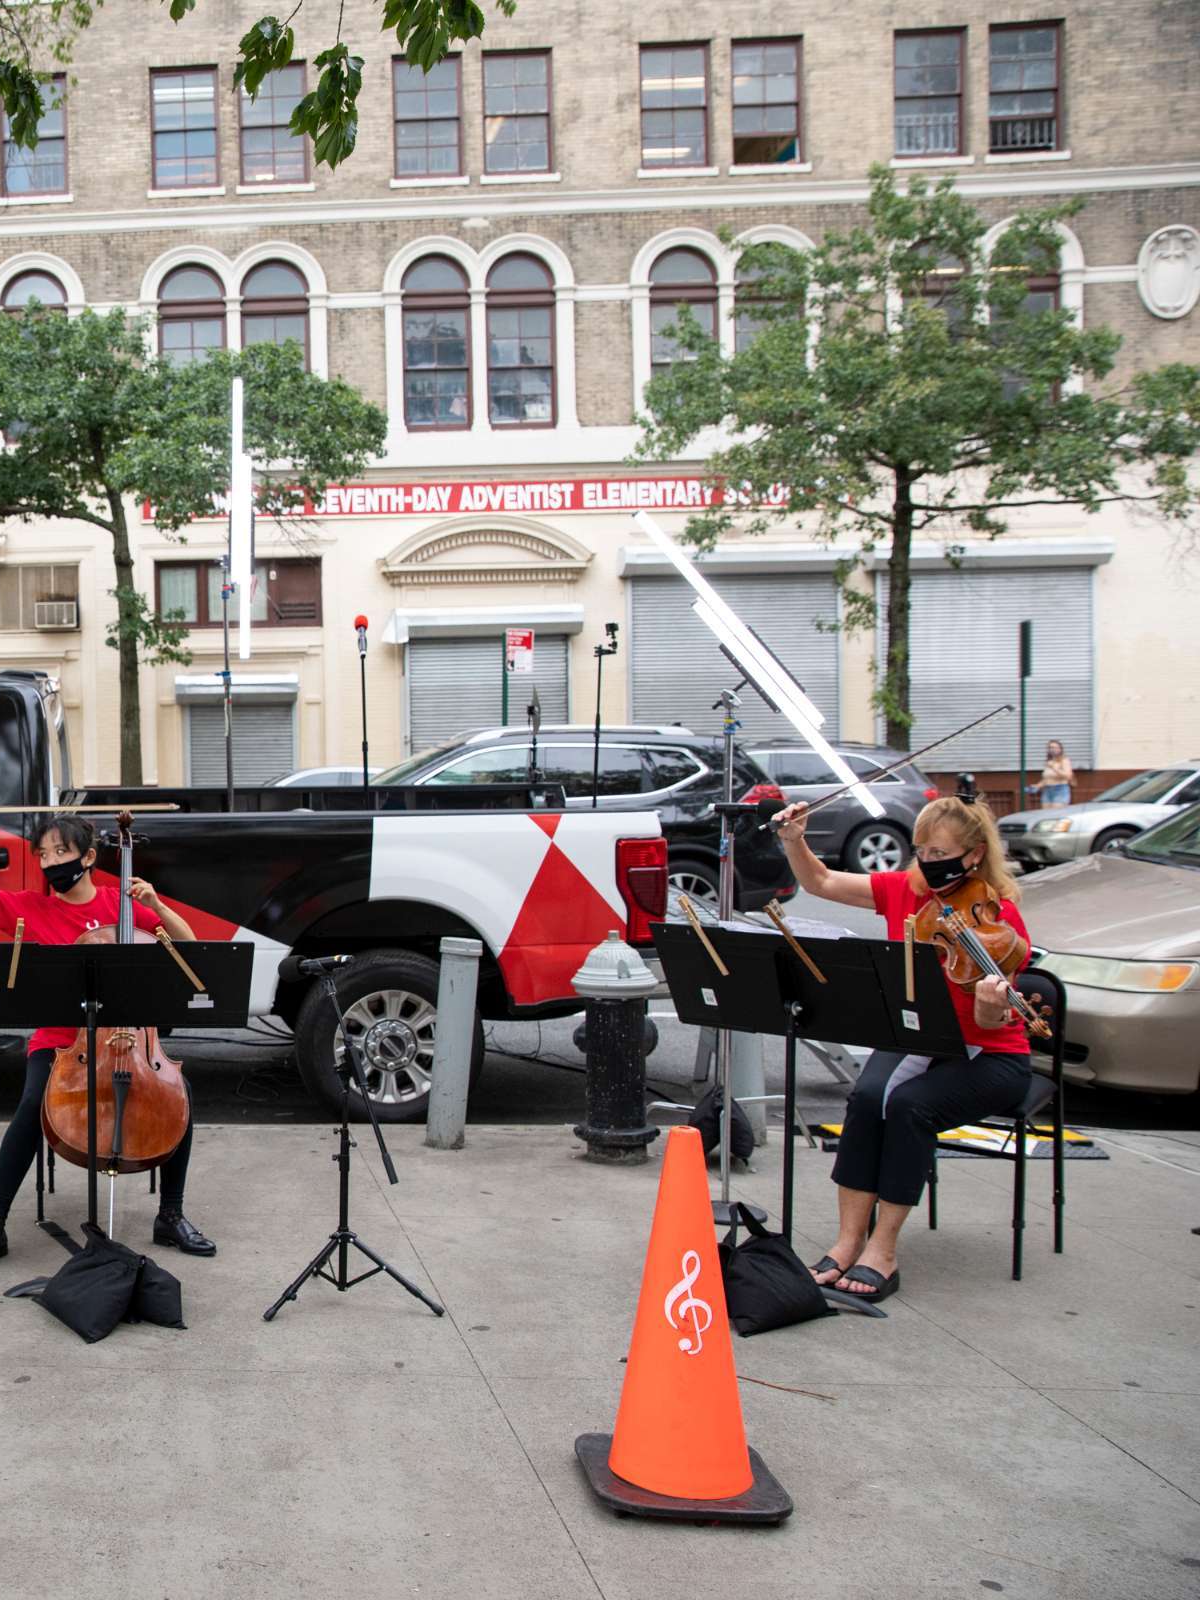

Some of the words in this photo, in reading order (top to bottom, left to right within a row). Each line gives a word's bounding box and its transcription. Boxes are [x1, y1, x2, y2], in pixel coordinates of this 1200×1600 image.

[314, 486, 453, 514] SEVENTH-DAY
[461, 482, 574, 510] ADVENTIST
[582, 480, 713, 508] ELEMENTARY
